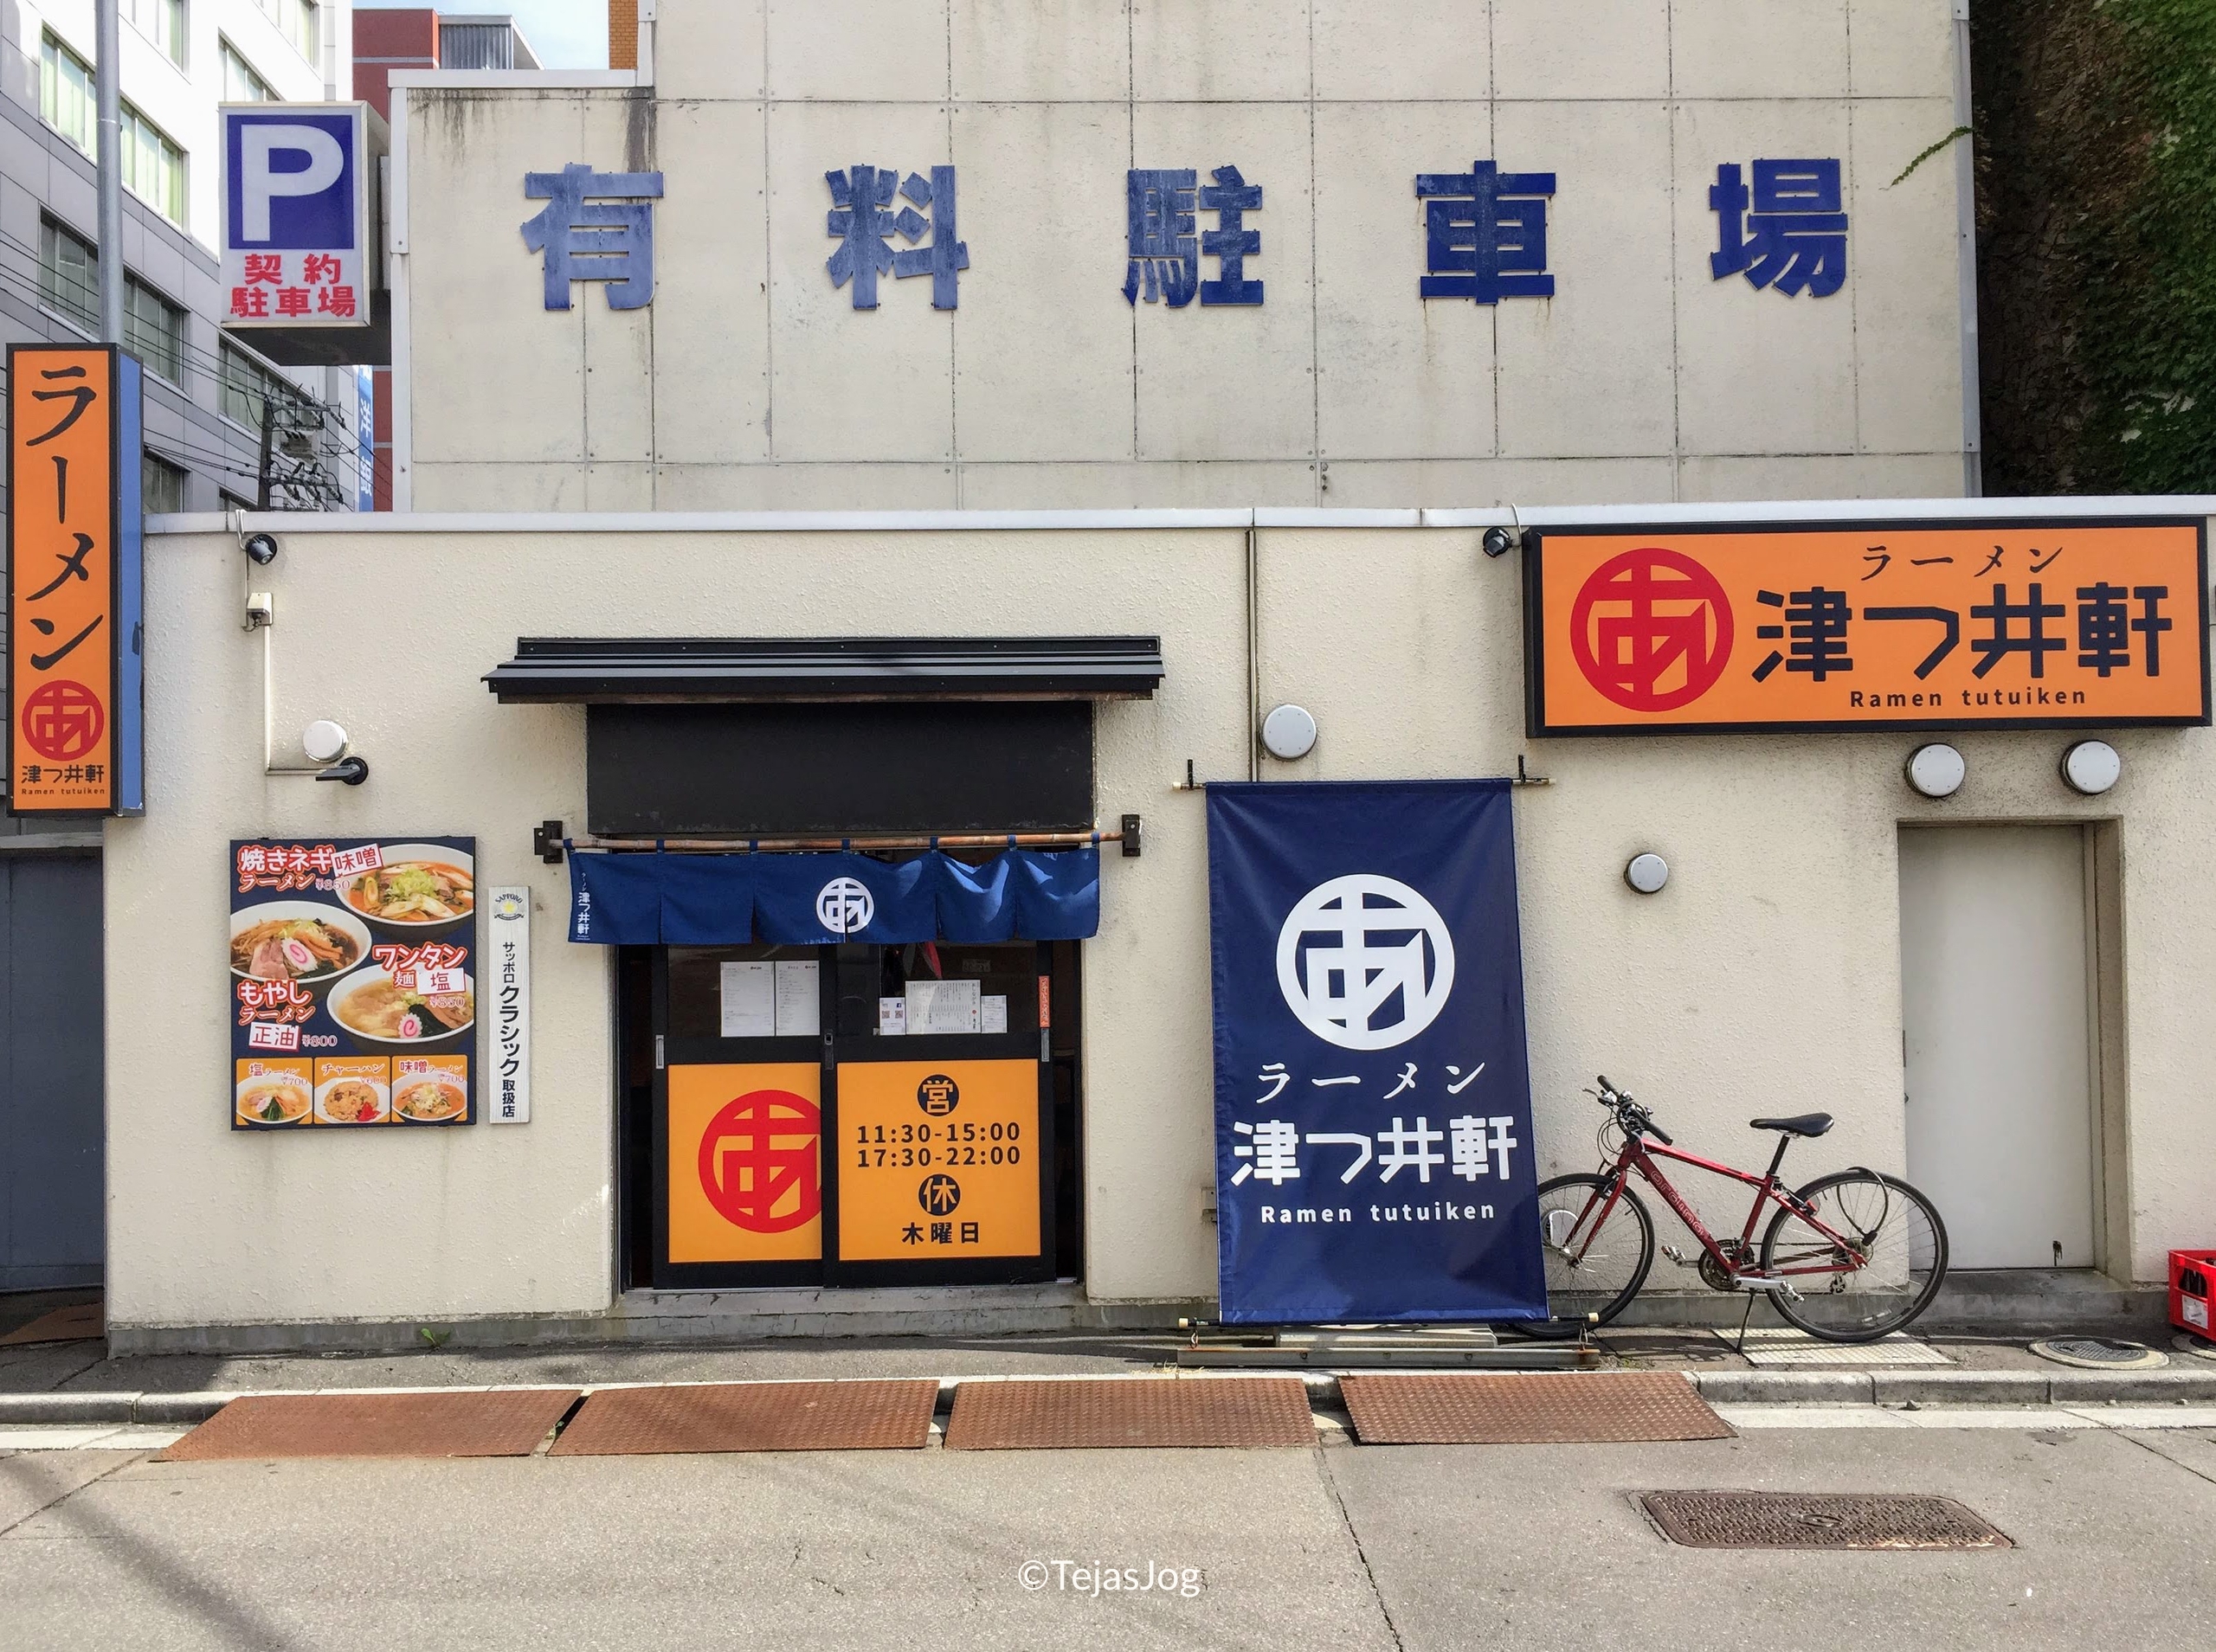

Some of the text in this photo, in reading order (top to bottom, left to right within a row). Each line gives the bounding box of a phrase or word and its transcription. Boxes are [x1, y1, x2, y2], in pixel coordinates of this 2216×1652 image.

[241, 124, 345, 242] P
[520, 158, 1848, 310] 有料駐車場
[243, 253, 342, 285] 契約
[229, 286, 356, 318] 駐車場
[26, 365, 104, 671] ラーメン
[1859, 544, 2064, 581] ラーメン
[1751, 582, 2172, 682] 津つ井軒
[1851, 686, 2086, 708] Ramen tutuiken
[21, 764, 105, 784] 津つ井軒
[239, 845, 334, 873] 焼きネギ
[334, 847, 377, 871] 味噌
[239, 873, 316, 892] ラーメン
[372, 942, 468, 971] ワンタン
[237, 979, 312, 1008] もやし
[430, 972, 451, 991] 塩
[238, 1005, 316, 1025] ラーメン
[252, 1025, 294, 1045] 正油
[321, 1063, 384, 1076] チャーハン
[1256, 1062, 1486, 1103] ラーメン
[921, 1079, 954, 1115] 営
[857, 1122, 1021, 1144] 11:30-15:00
[857, 1146, 1021, 1167] 17:30-22:00
[1230, 1115, 1517, 1186] 津つ井軒
[923, 1178, 957, 1212] 休
[1260, 1201, 1495, 1225] Ramen tutuiken
[902, 1222, 980, 1244] 木曜日
